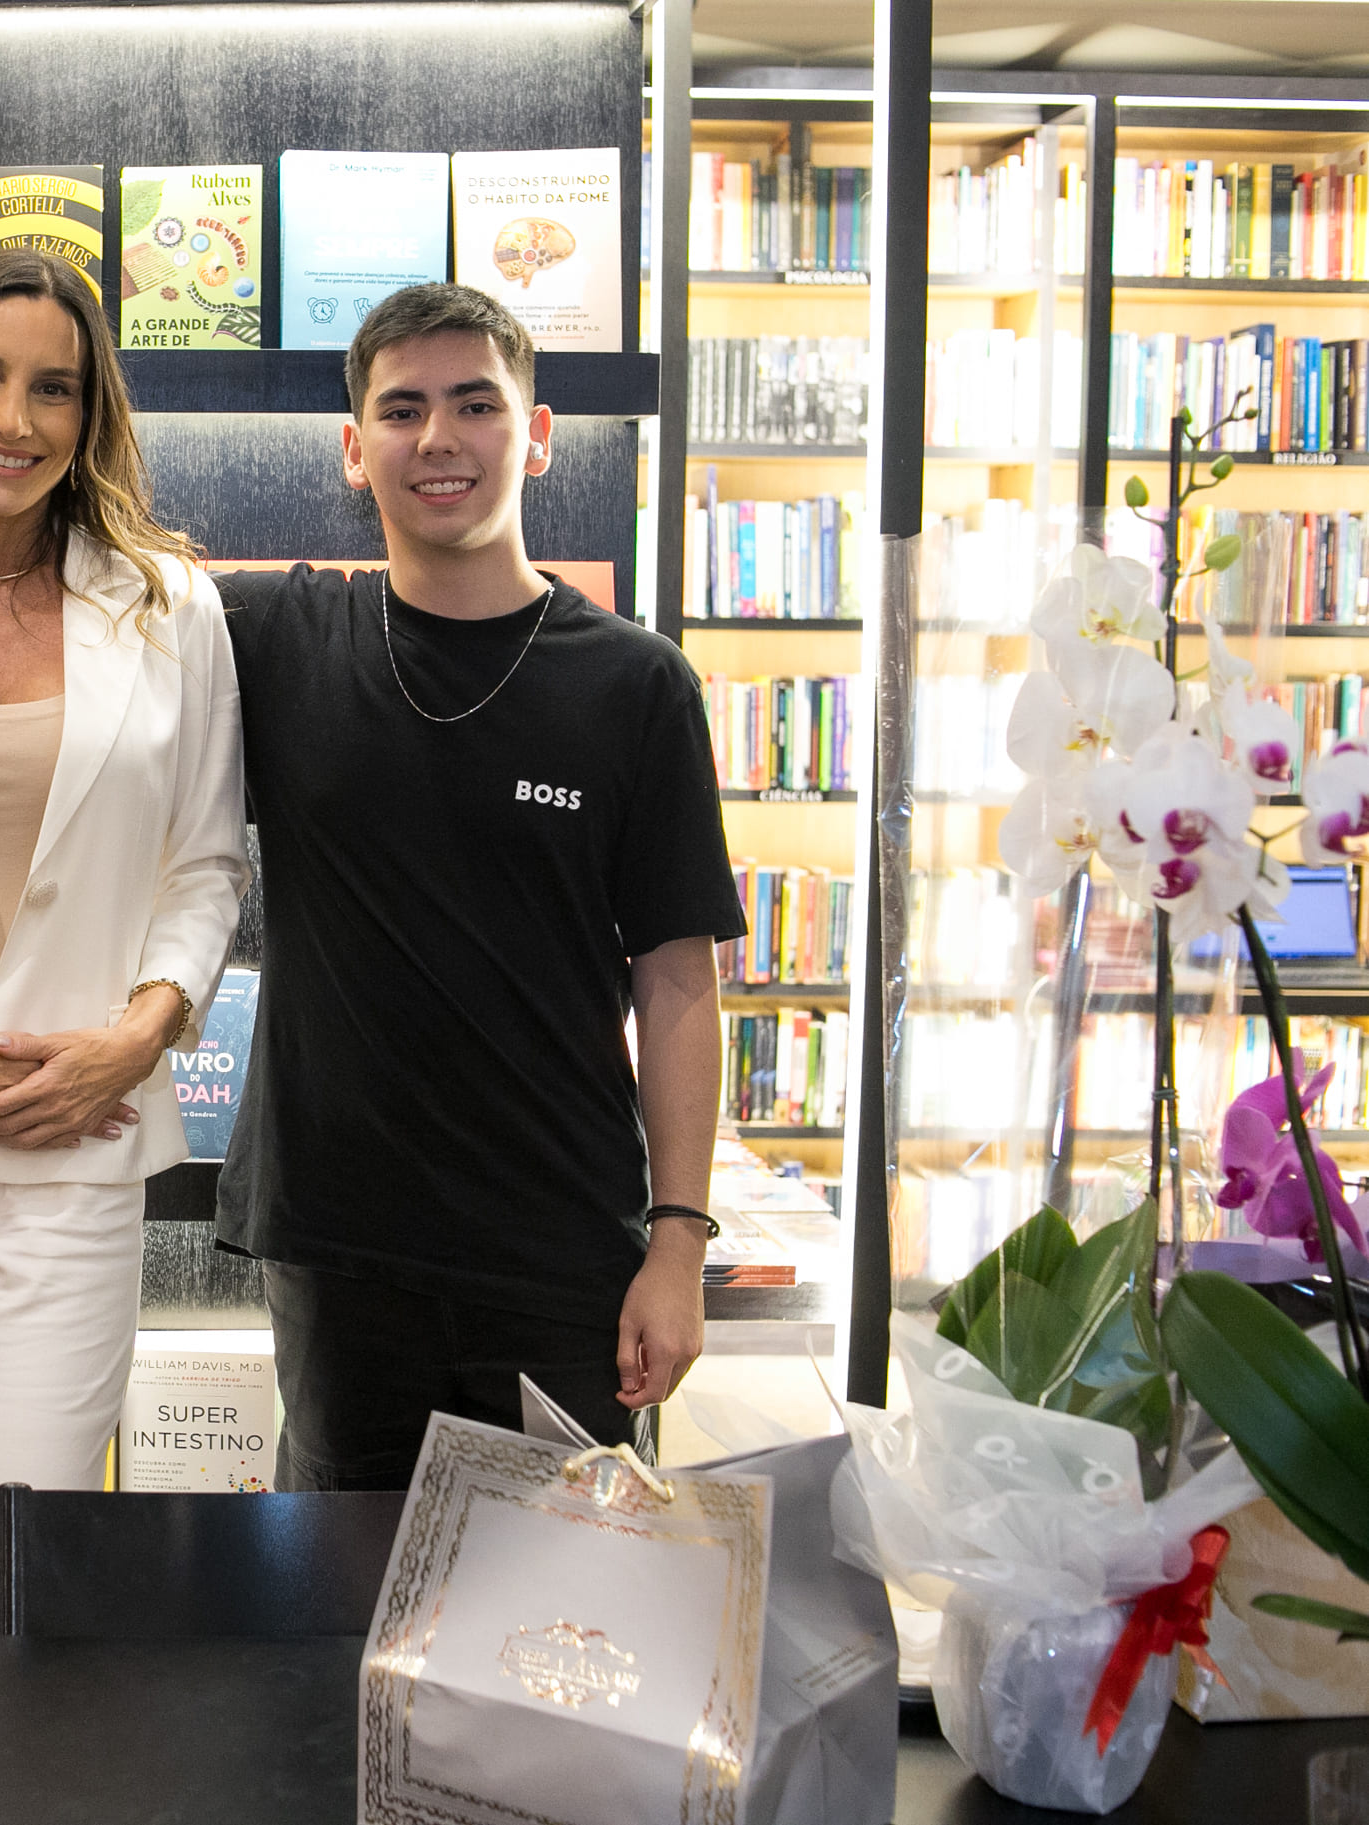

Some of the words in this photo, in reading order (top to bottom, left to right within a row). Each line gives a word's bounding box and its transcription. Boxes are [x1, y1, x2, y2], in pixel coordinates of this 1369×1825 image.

[32, 177, 78, 198] SERGIO
[191, 173, 251, 188] Rubem
[468, 174, 610, 187] DESCONSTRUINDO
[0, 196, 65, 216] CORTELLA
[208, 190, 251, 206] Alves
[468, 194, 479, 204] O
[545, 193, 564, 204] DA
[569, 192, 610, 203] FOME
[32, 235, 93, 268] FAZEMOS
[131, 319, 141, 330] A
[146, 319, 210, 330] GRANDE
[131, 335, 167, 346] ARTE
[172, 335, 190, 346] DE
[515, 780, 582, 810] BOSS
[171, 1052, 234, 1073] IVRO
[190, 1074, 201, 1082] DO
[175, 1083, 230, 1104] DAH
[131, 1359, 187, 1370] WILLIAM
[192, 1361, 235, 1373] DAVIS,
[239, 1362, 265, 1373] M.D.
[158, 1405, 238, 1424] SUPER
[133, 1431, 263, 1451] INTESTINO
